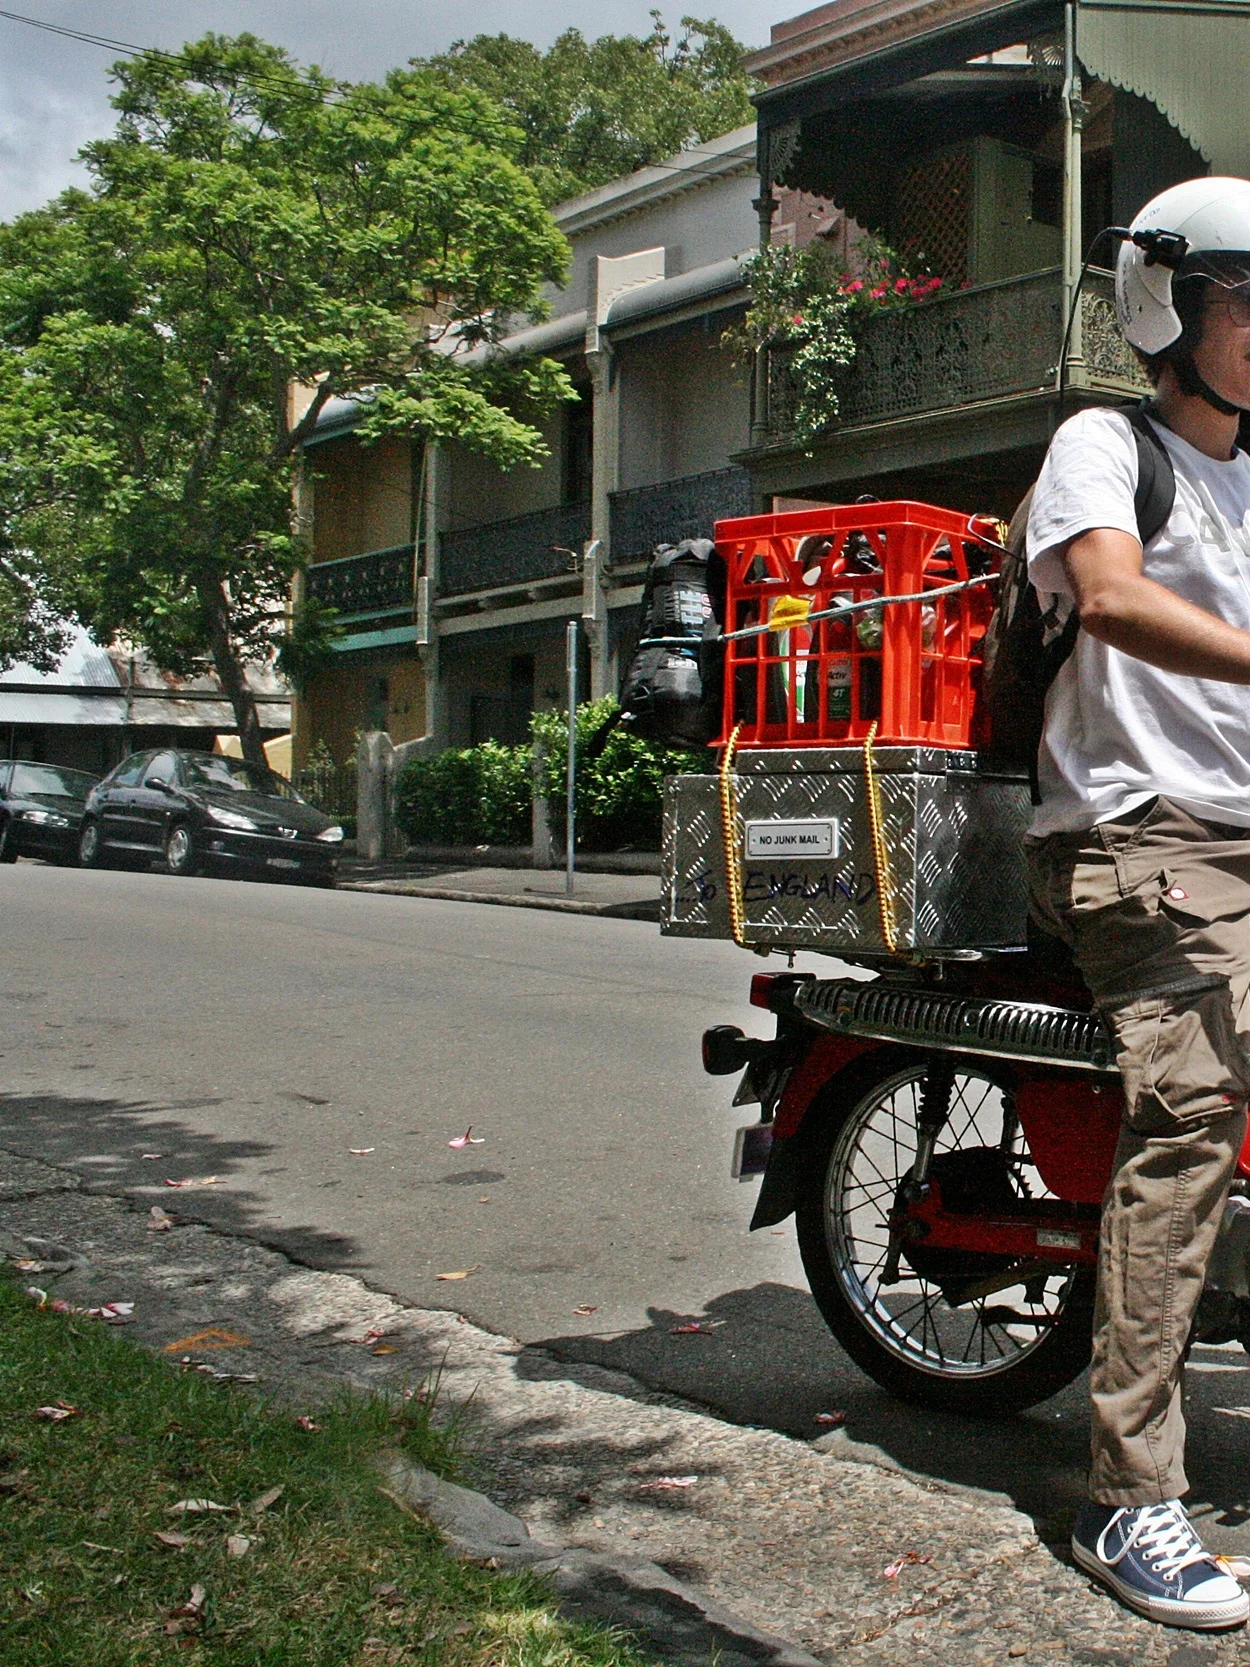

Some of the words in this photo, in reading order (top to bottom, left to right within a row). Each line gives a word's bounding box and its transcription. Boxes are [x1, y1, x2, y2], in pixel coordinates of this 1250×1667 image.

[760, 836, 772, 845] NO
[774, 835, 797, 844] JUNK
[799, 835, 820, 844] MAIL
[742, 871, 876, 905] ENGLAND
